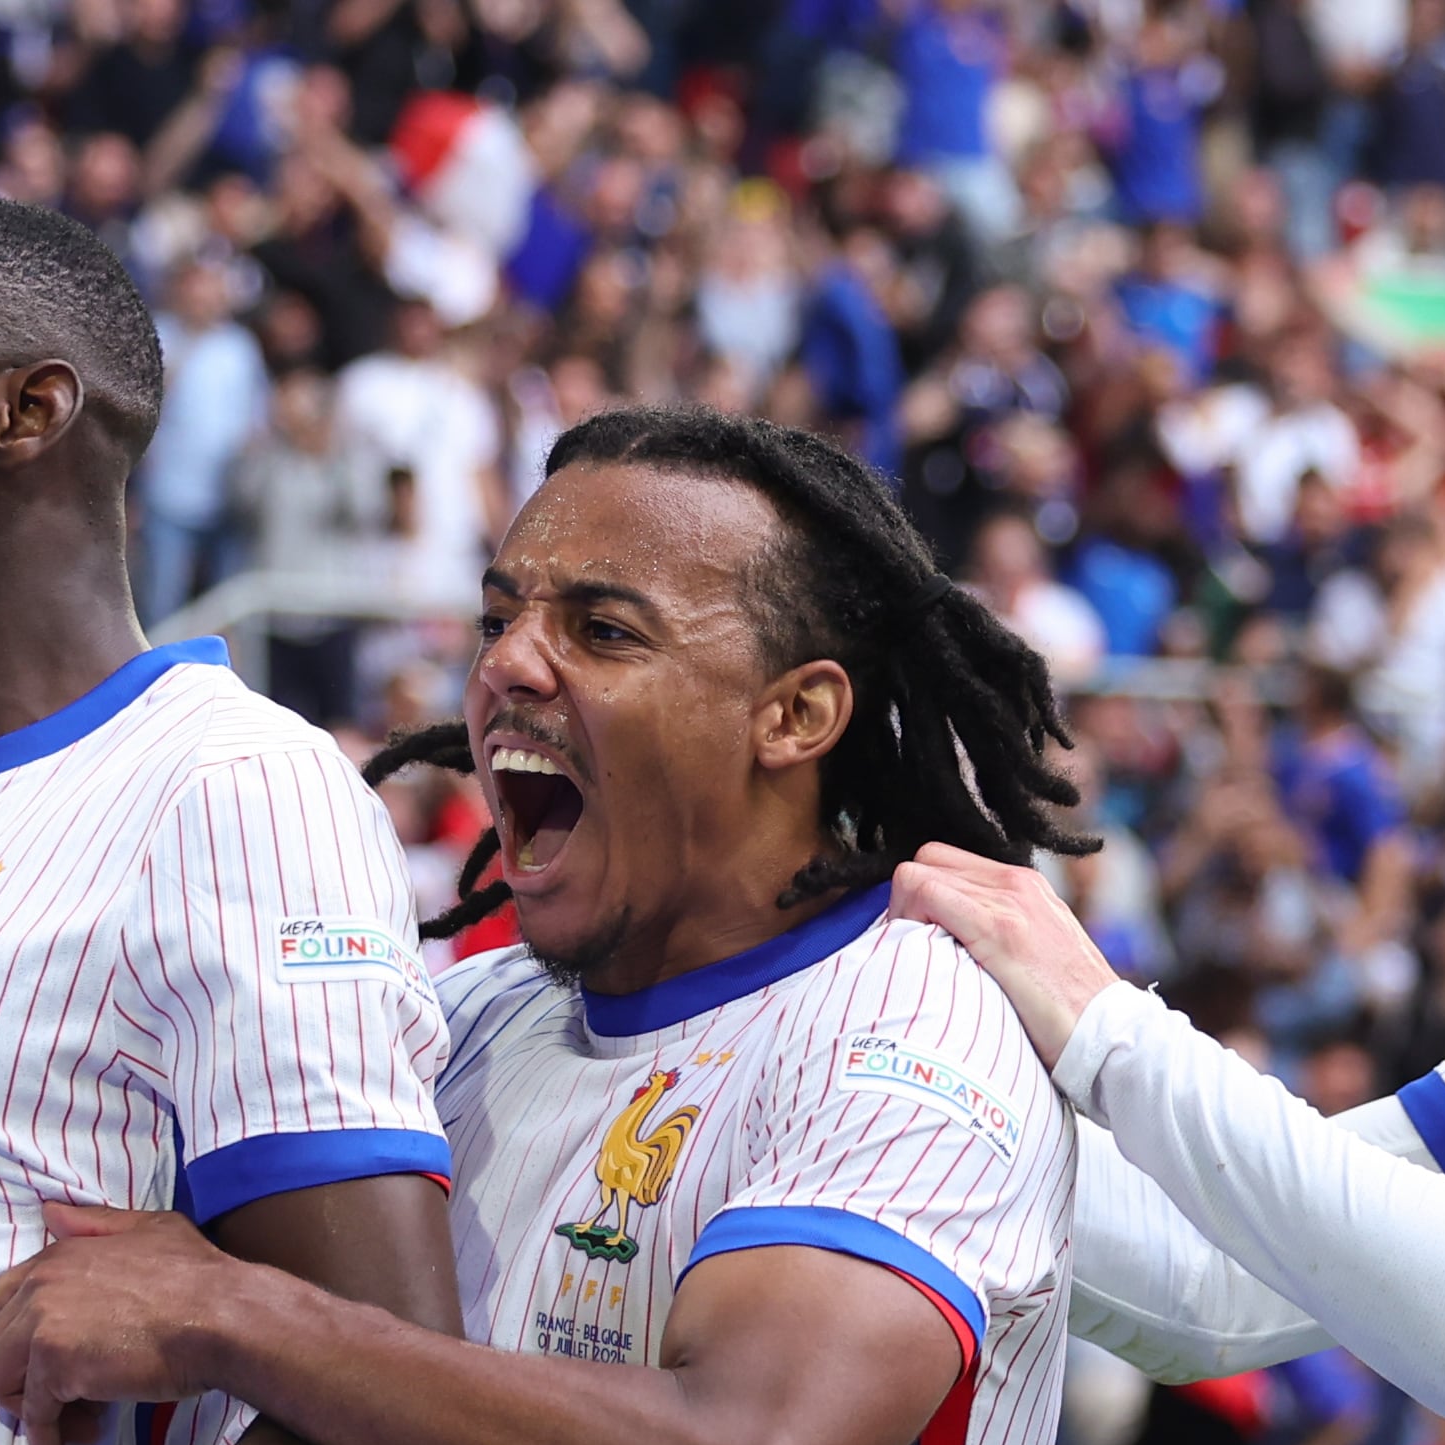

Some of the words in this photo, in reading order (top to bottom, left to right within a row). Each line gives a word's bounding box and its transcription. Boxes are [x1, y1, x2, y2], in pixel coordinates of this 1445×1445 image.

[280, 921, 324, 935] UEFA
[852, 1036, 898, 1051] UEFA
[536, 1312, 575, 1335] FRANCE
[583, 1324, 633, 1350] BELGIQUE
